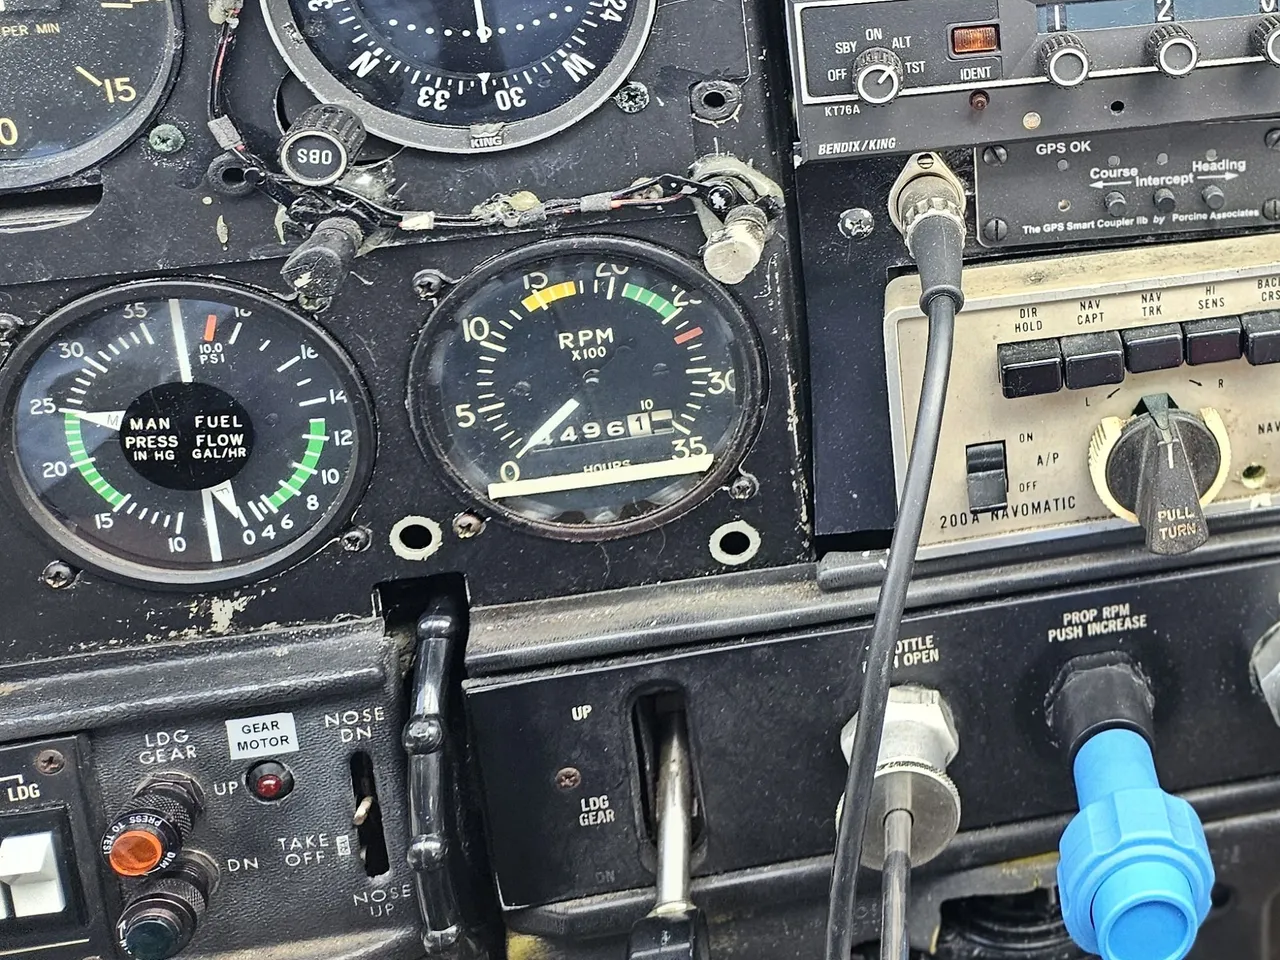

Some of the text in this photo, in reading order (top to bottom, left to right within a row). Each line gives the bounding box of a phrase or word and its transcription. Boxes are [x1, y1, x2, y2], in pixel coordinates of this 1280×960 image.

[865, 28, 882, 41] ON
[835, 41, 857, 54] SBY
[891, 36, 912, 50] ALT
[905, 61, 926, 74] TST
[960, 66, 992, 81] IDENT
[827, 69, 847, 82] OFF
[824, 105, 861, 117] KT76A
[818, 138, 896, 156] BENDIX/KING
[1036, 141, 1091, 156] GPS OK
[1089, 166, 1139, 179] Course
[1192, 158, 1246, 173] Heading
[1135, 172, 1195, 188] Intercept
[1022, 224, 1041, 234] The
[1043, 222, 1064, 233] GPS
[1066, 220, 1095, 232] Smart
[1096, 217, 1135, 232] Coupler
[1153, 215, 1165, 227] by
[1171, 211, 1209, 222] Porcine
[1209, 208, 1260, 221] Associates
[1198, 296, 1225, 310] SENS
[1014, 320, 1043, 332] HOLD
[1077, 312, 1105, 326] CAPT
[462, 317, 490, 342] 10
[558, 328, 615, 350] RPM
[571, 346, 607, 362] X100
[129, 417, 171, 430] MAN
[194, 415, 243, 429] FUEL
[125, 435, 179, 449] PRESS
[196, 433, 244, 448] FLOW
[192, 446, 247, 459] GAL/HR
[42, 461, 68, 479] 20
[990, 495, 1076, 522] NAVOMATIC
[1062, 603, 1130, 626] PROP RPM
[1047, 614, 1148, 643] PUSH INCREASE
[903, 648, 940, 667] OPEN
[324, 707, 385, 728] NOSE
[572, 704, 592, 721] UP
[242, 720, 280, 735] GEAR
[341, 725, 373, 742] DN
[146, 730, 190, 748] LDG
[237, 735, 290, 751] MOTOR
[139, 746, 198, 765] GEAR
[8, 785, 40, 803] LDG
[214, 781, 238, 796] UP
[581, 795, 609, 813] LDG
[129, 815, 163, 827] PRESS
[579, 809, 615, 826] GEAR
[111, 821, 126, 833] TO
[278, 834, 329, 852] TAKE
[228, 857, 258, 872] DN
[285, 851, 326, 867] OFF
[354, 884, 411, 906] NOSE
